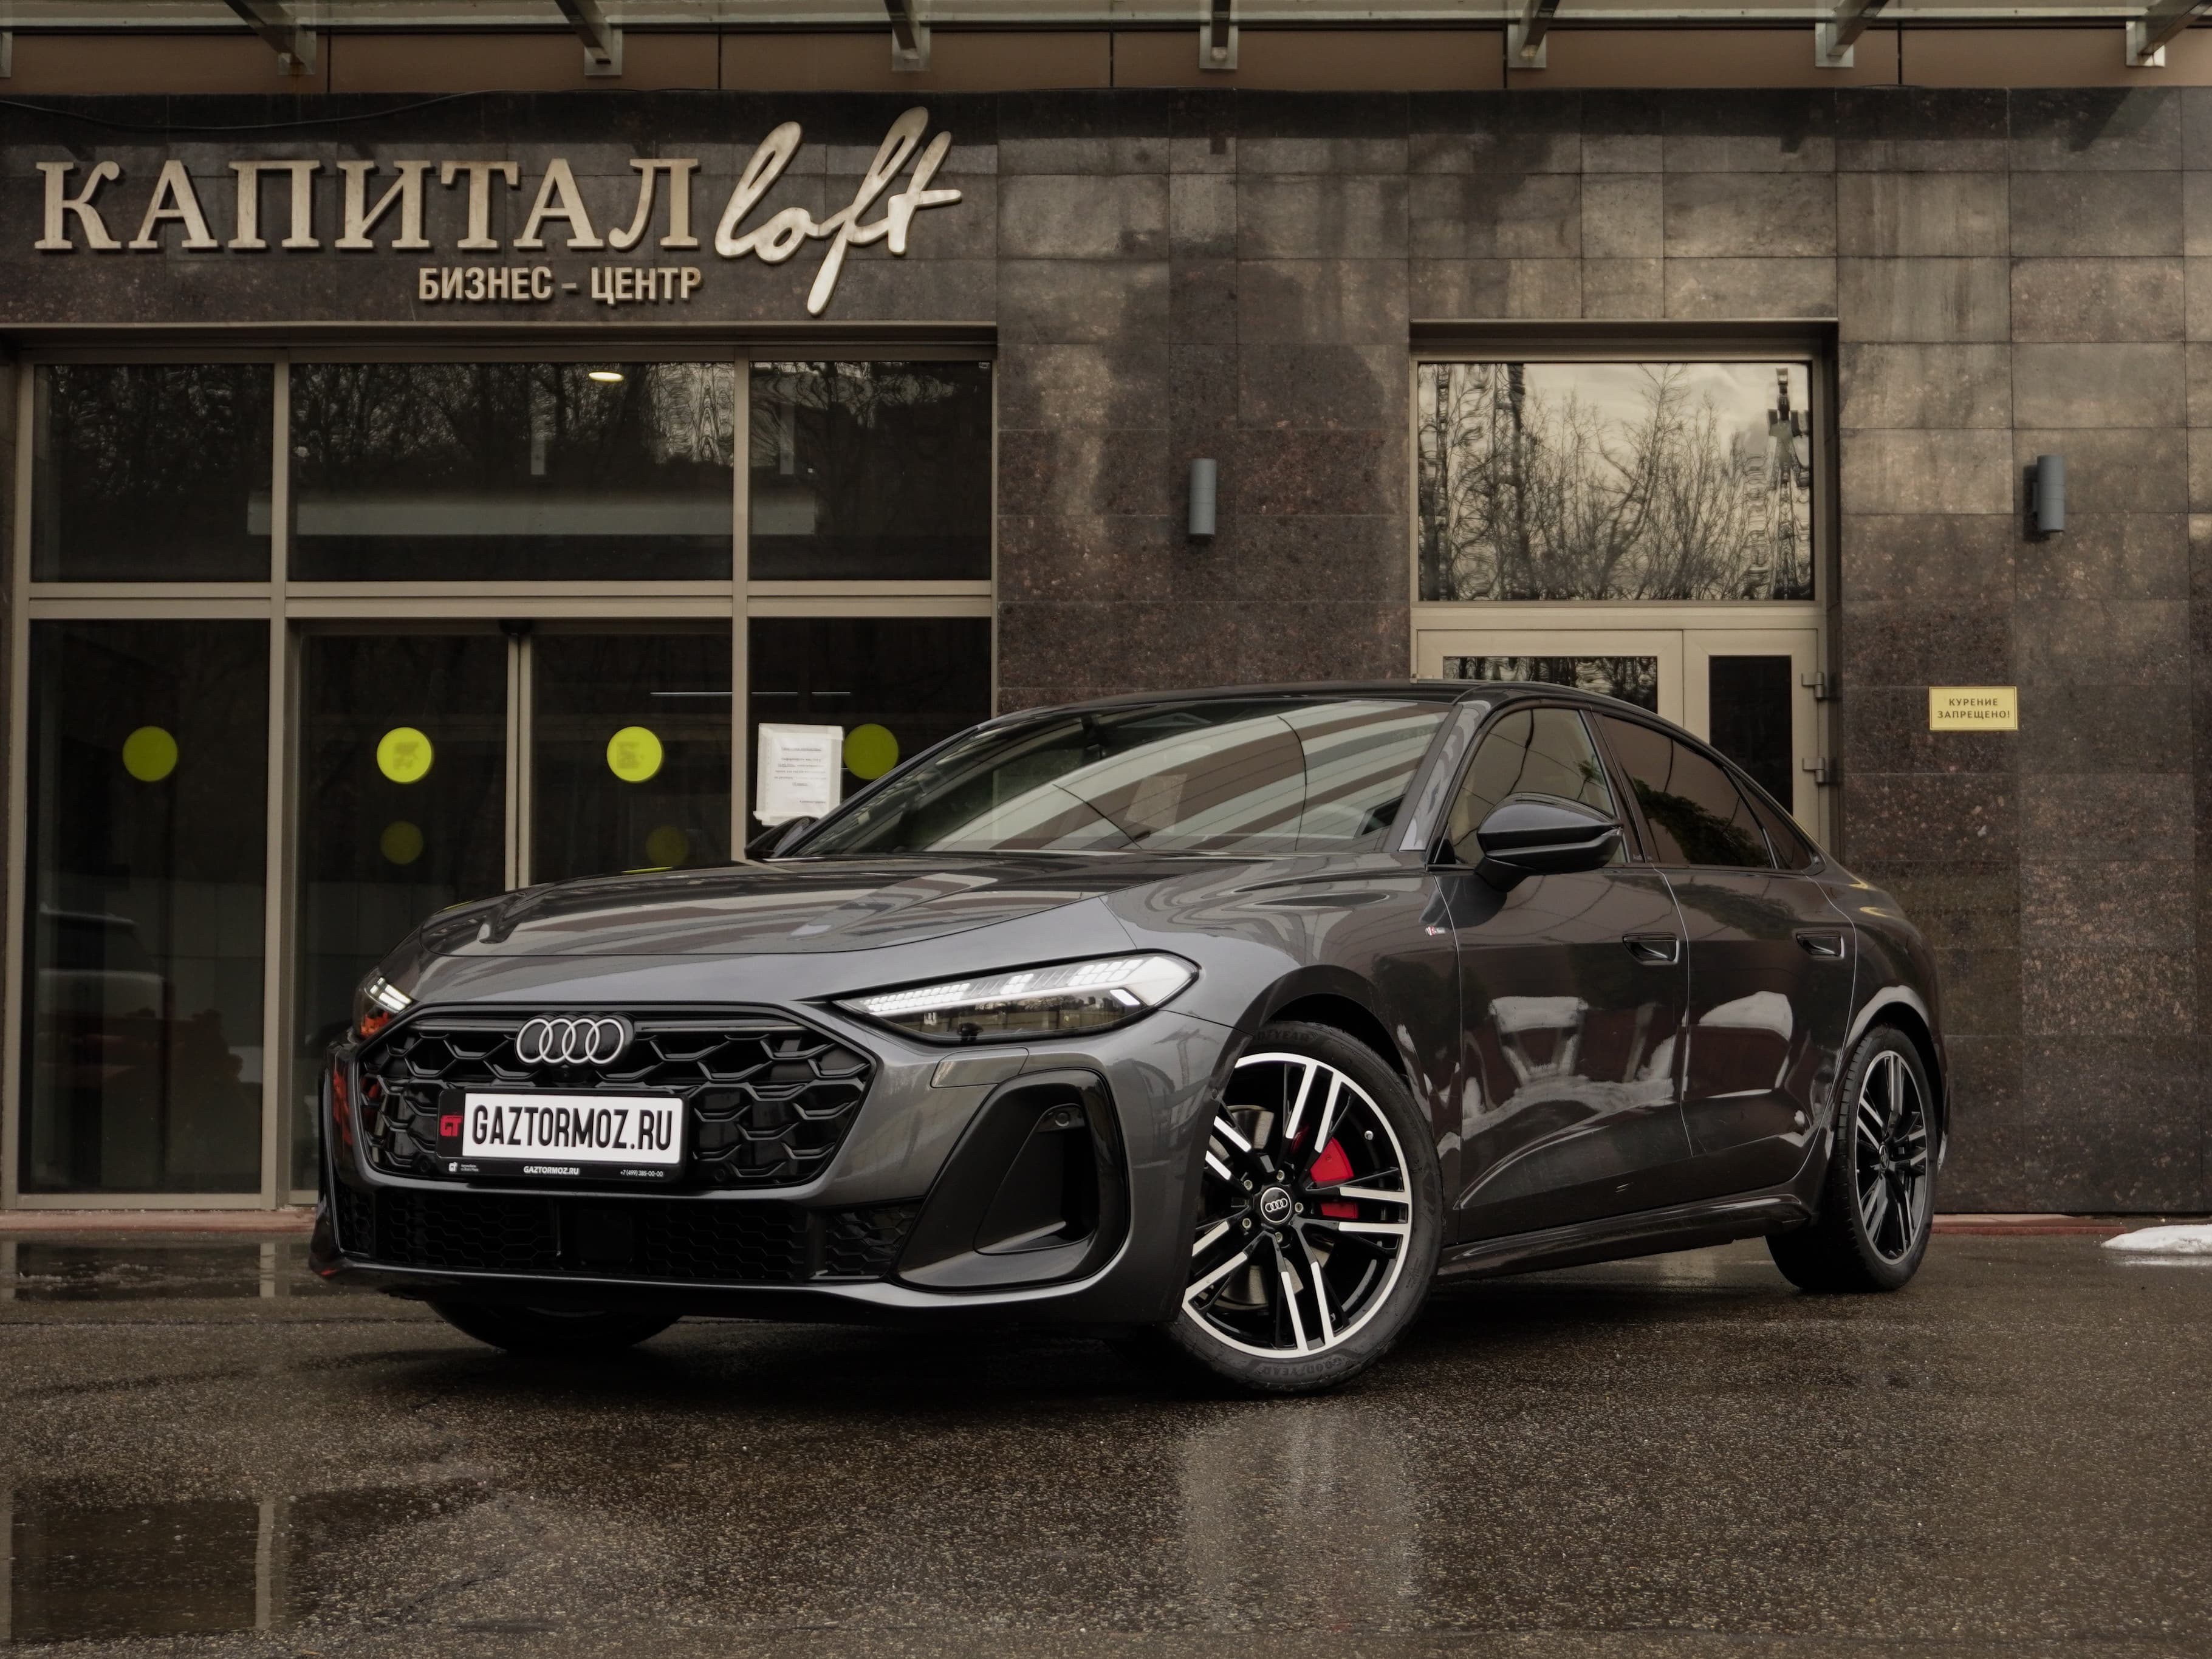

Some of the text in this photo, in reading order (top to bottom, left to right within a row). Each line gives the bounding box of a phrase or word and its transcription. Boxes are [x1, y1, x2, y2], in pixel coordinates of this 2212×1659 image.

[34, 159, 700, 250] КАПИТАЛ
[715, 106, 963, 316] loft
[419, 267, 553, 301] БИЗНЕС
[591, 266, 701, 306] ЦЕНТР
[1937, 710, 2010, 719] ЗАПРЕЩЕНО!
[471, 1104, 673, 1151] GAZTORMOZ.RU
[523, 1165, 580, 1175] GAZTORMOZ.RU
